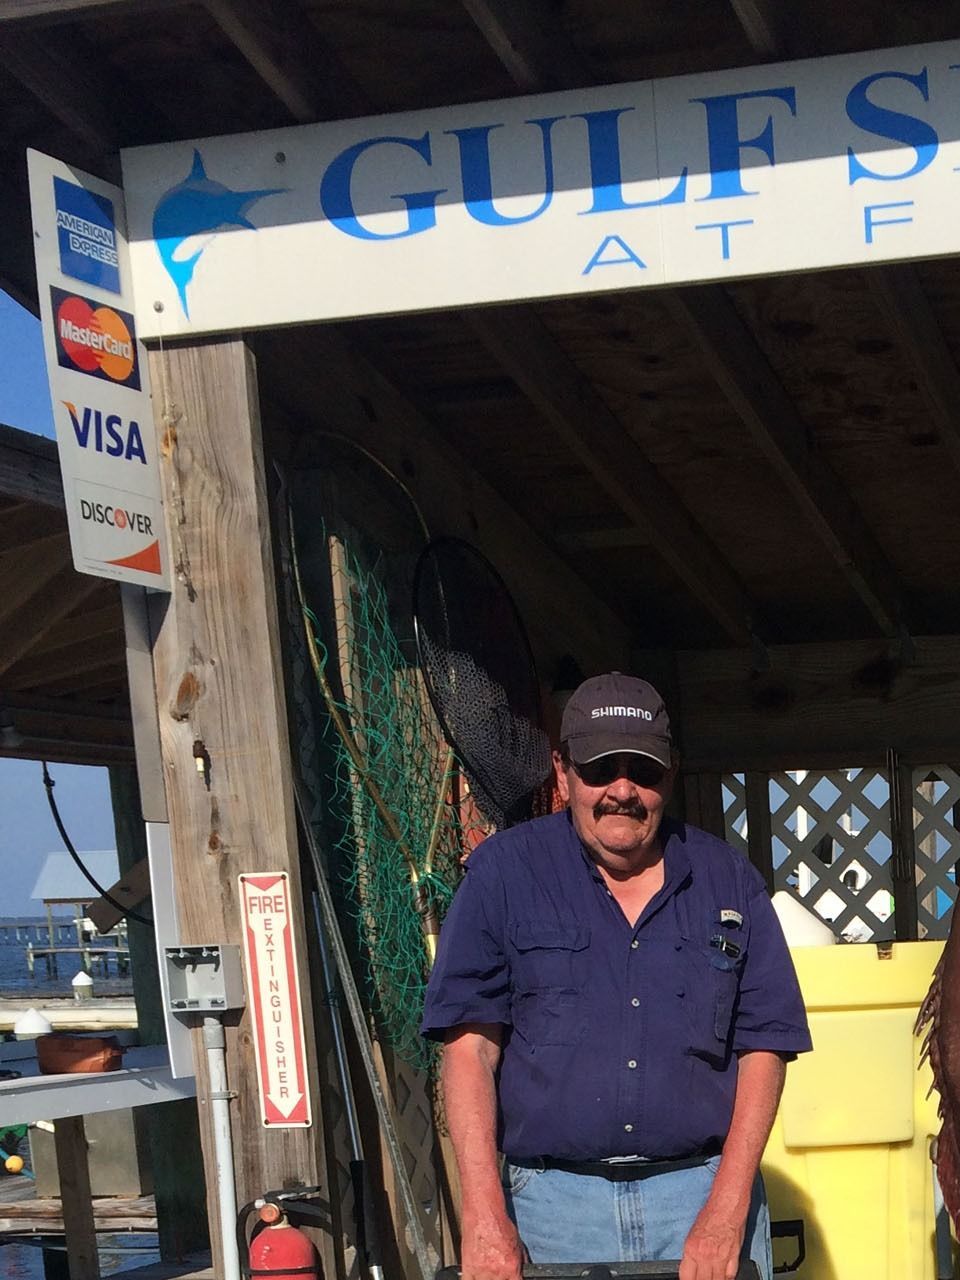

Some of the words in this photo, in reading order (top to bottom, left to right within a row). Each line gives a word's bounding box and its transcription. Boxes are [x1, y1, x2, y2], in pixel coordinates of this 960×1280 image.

[319, 86, 797, 242] GULF
[56, 210, 114, 246] AMERICAN
[69, 234, 118, 267] EXPRESS
[582, 220, 754, 276] AT
[60, 318, 132, 360] MasterCard
[62, 401, 147, 465] VISA
[80, 499, 154, 536] DISCOVER
[591, 706, 652, 721] SHIMANO
[249, 895, 285, 914] FIRE
[263, 918, 289, 1098] EXTINGUISHER
